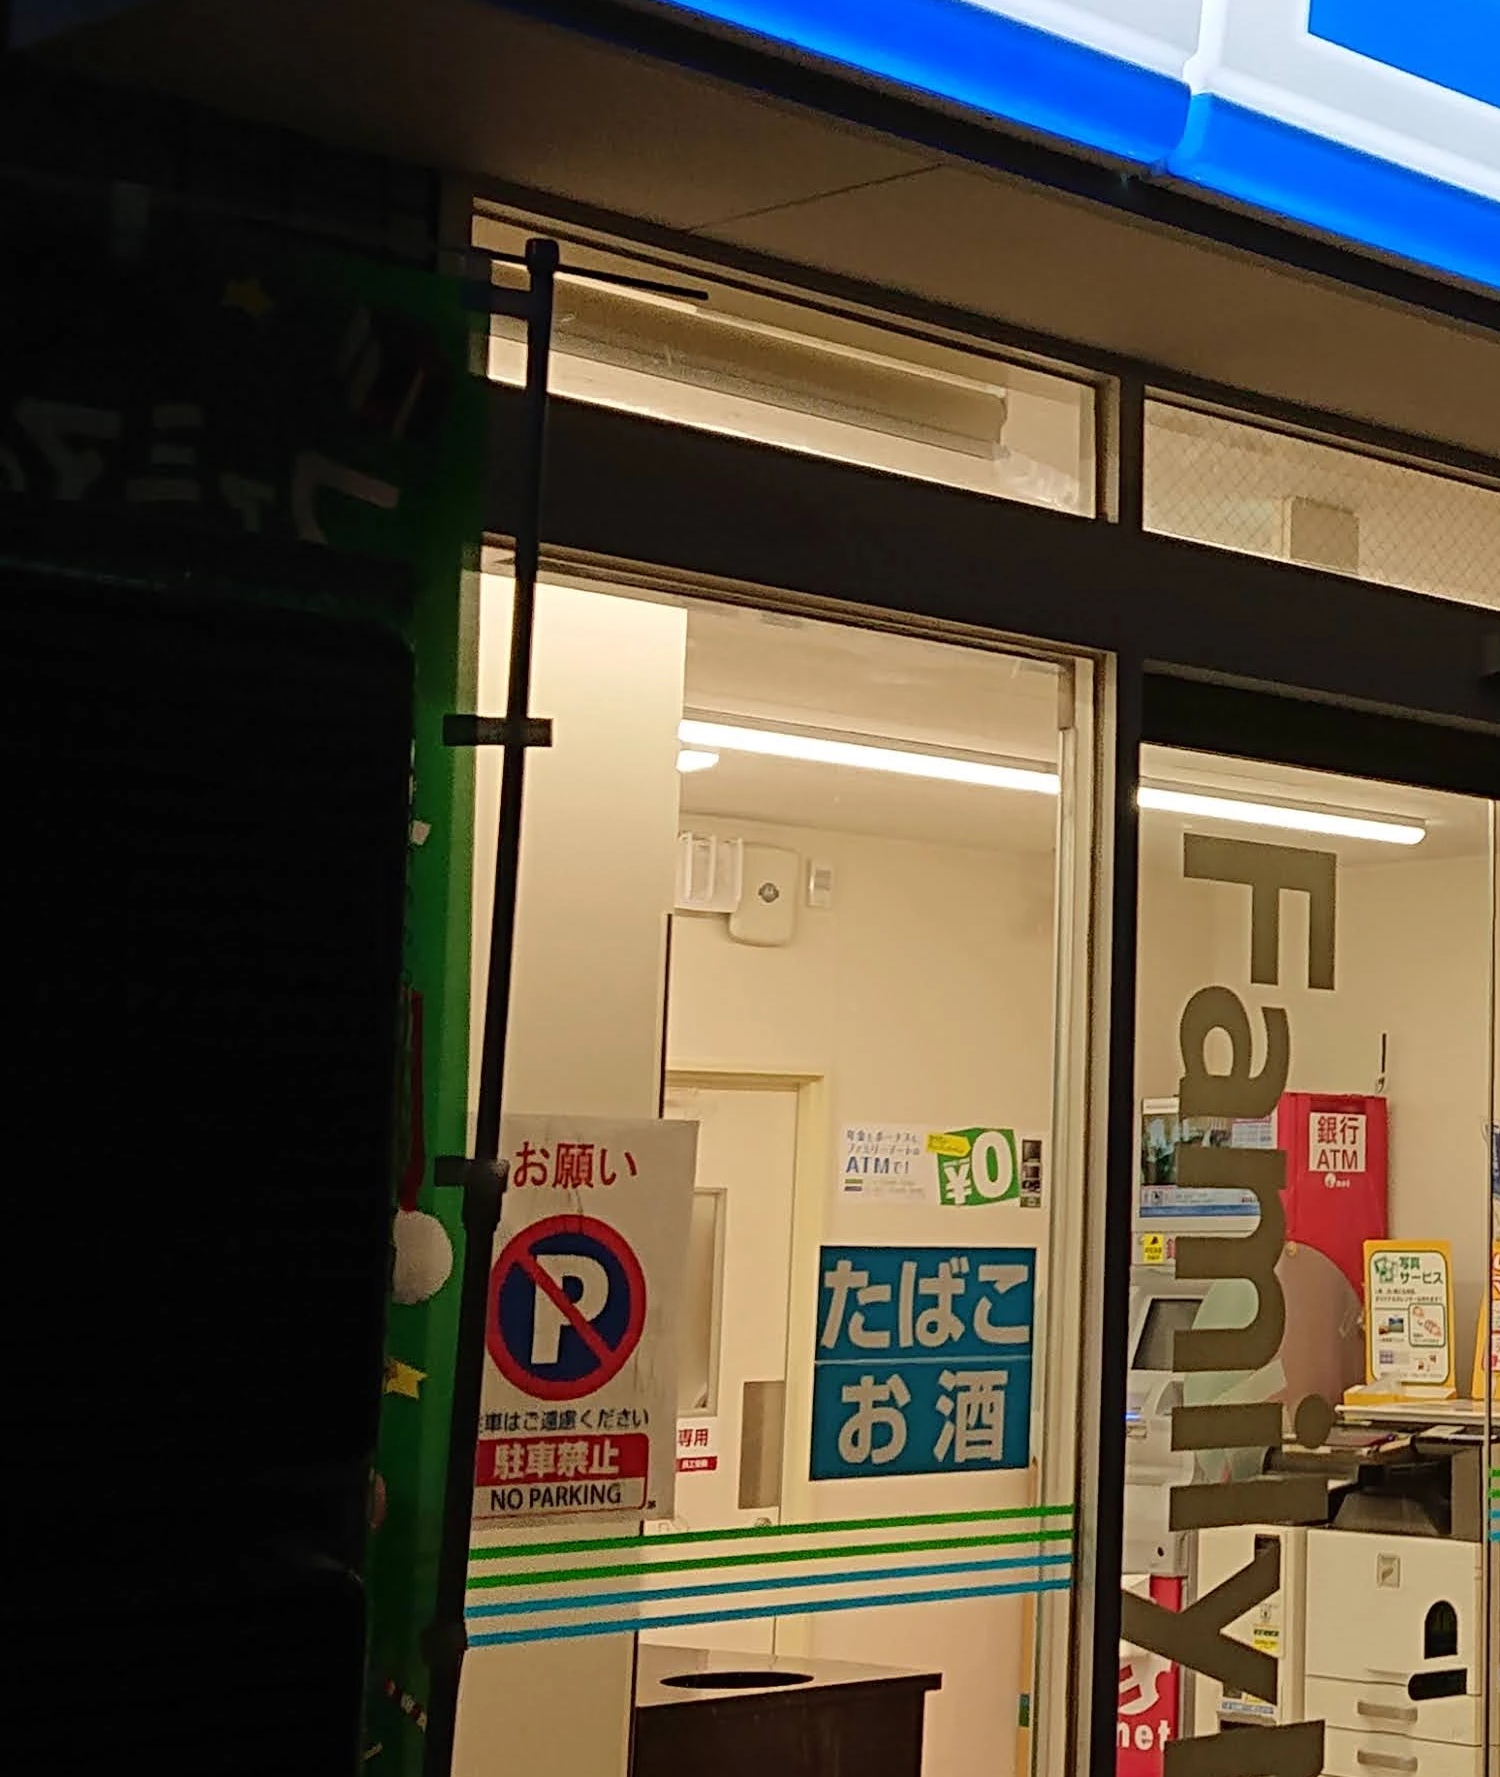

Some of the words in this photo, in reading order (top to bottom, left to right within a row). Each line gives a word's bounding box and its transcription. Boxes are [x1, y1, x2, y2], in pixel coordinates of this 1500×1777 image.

[1317, 1115, 1360, 1146] 銀行
[512, 1142, 638, 1192] お願い
[1317, 1148, 1359, 1171] ATM
[1399, 1269, 1444, 1285] サービス
[821, 1257, 1030, 1351] たばこ
[480, 1408, 648, 1435] 車はご遠慮ください
[835, 1369, 1010, 1465] お酒
[678, 1428, 709, 1448] 専用
[493, 1439, 620, 1480] 駐車禁止
[490, 1487, 524, 1512] NO
[529, 1482, 622, 1509] PARKING
